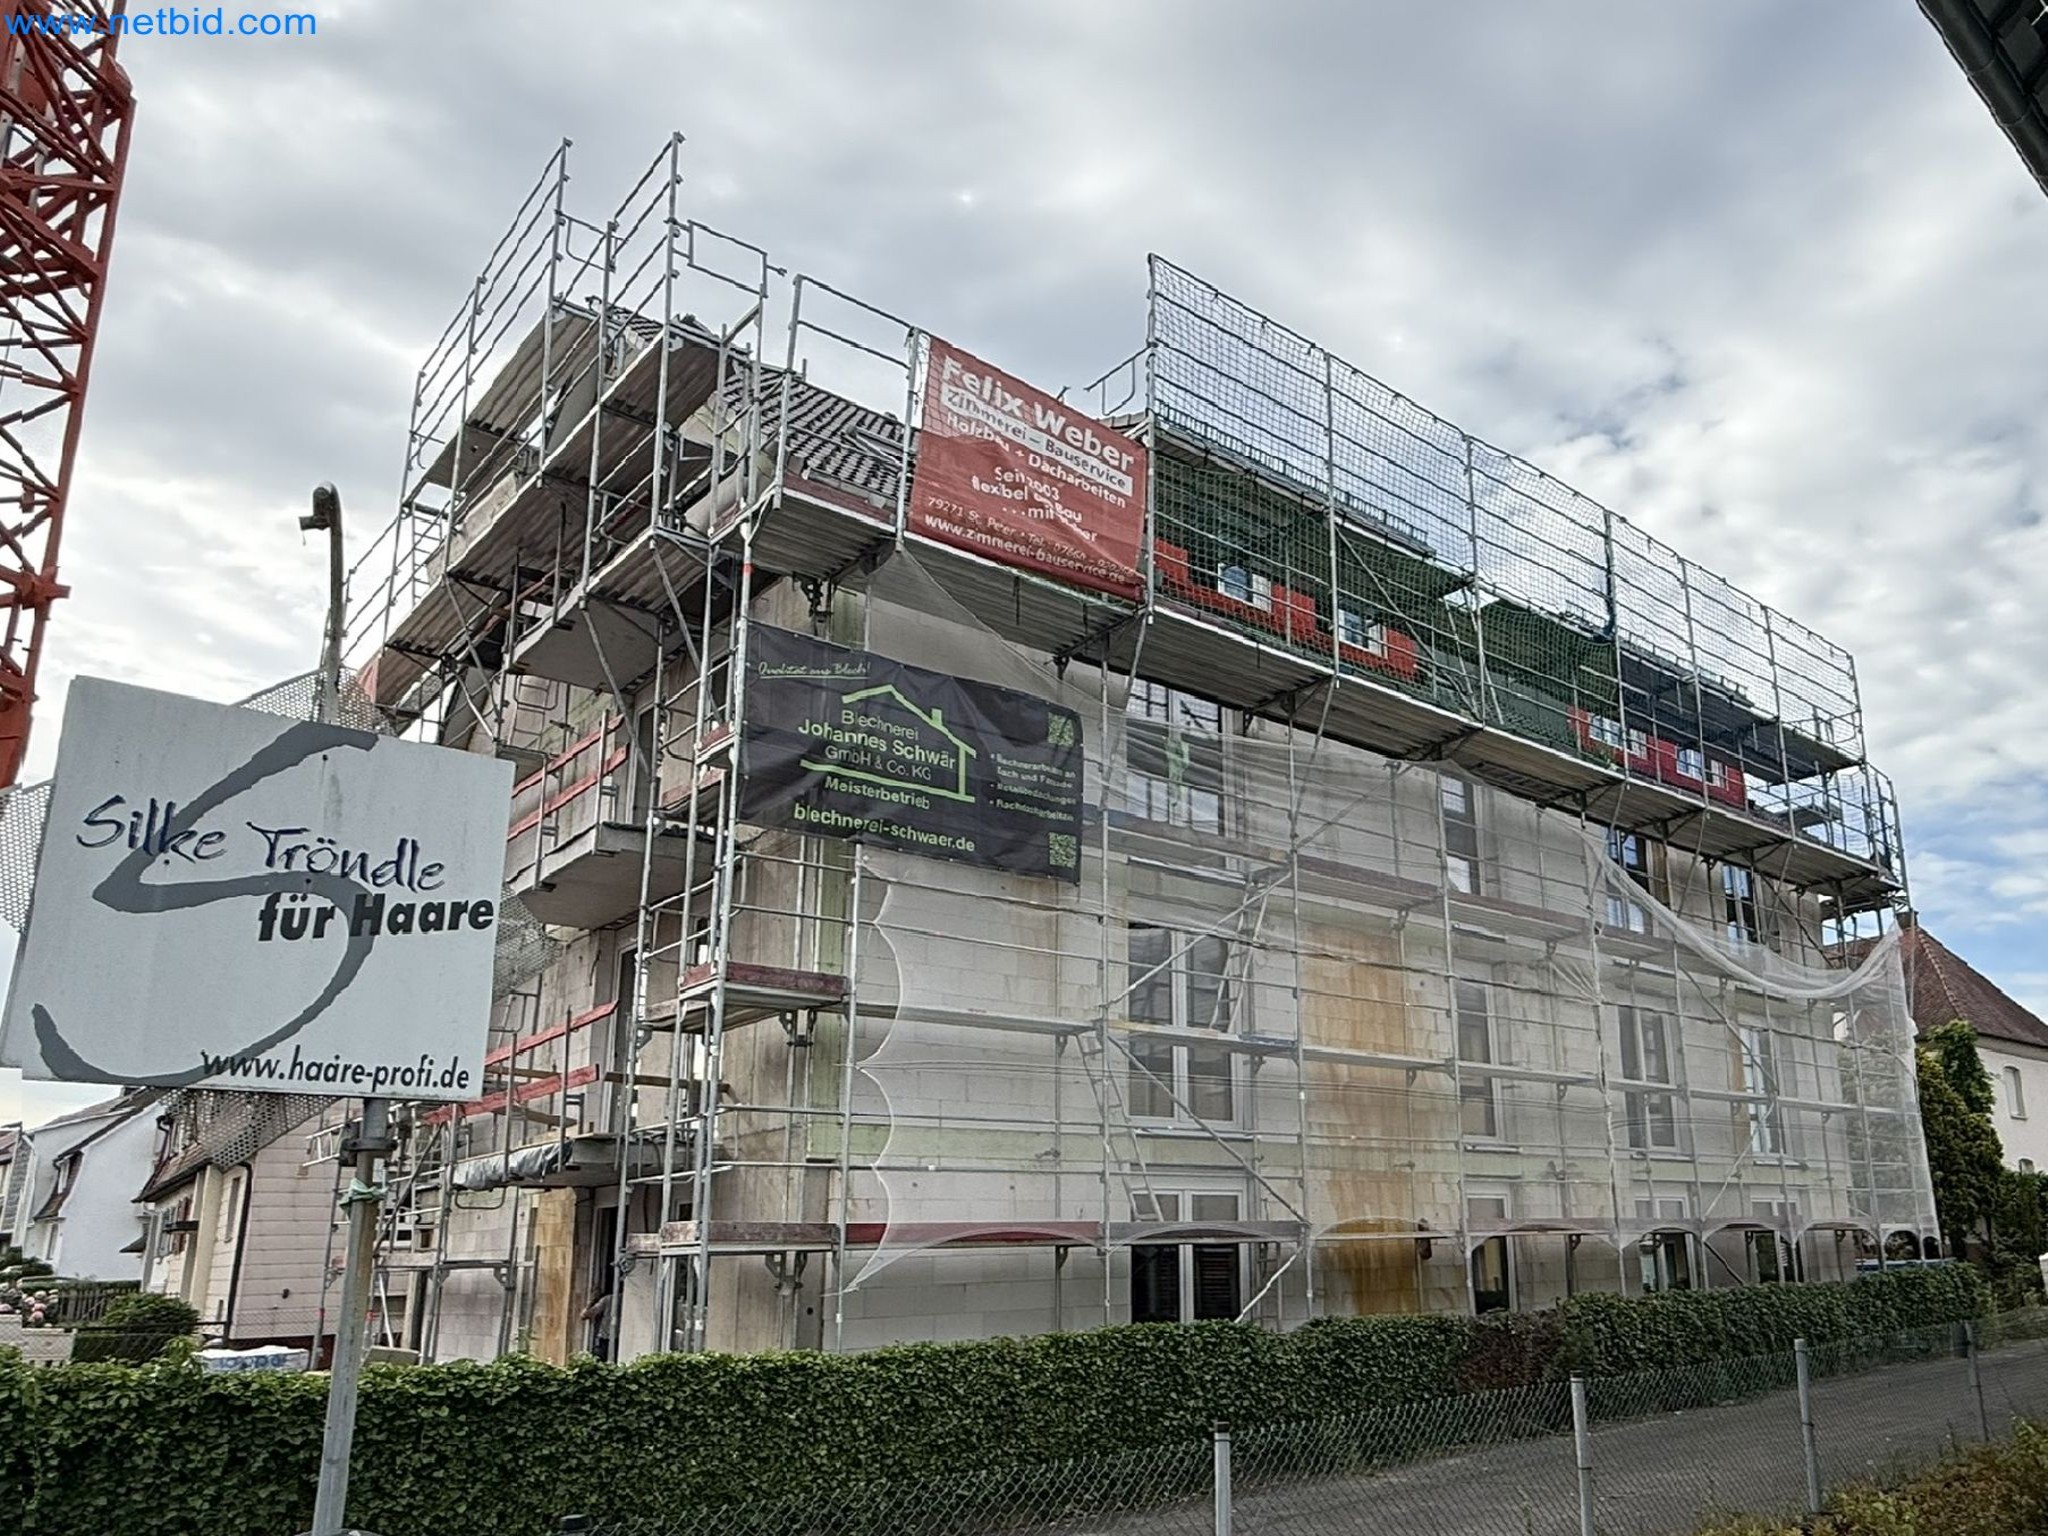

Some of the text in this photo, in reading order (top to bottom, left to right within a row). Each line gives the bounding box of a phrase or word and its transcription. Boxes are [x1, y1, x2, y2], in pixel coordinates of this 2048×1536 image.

[942, 355, 1134, 472] Felix Weber
[1028, 453, 1126, 509] Dacharbeiten
[1045, 438, 1126, 489] Bauservice
[927, 497, 964, 517] 79271
[924, 514, 1126, 583] www.zimmerei-bauservice.de
[798, 719, 957, 770] Johannes Schwär
[841, 709, 919, 741] Blechnerei
[825, 745, 932, 781] GmbH & Co. KG
[824, 776, 931, 810] Meisterbetrieb
[76, 795, 446, 893] Silke Tröndle
[794, 802, 976, 852] blechnerei-schwaer.de
[258, 892, 494, 942] für Haare
[201, 1045, 470, 1093] www.haare-profi.de
